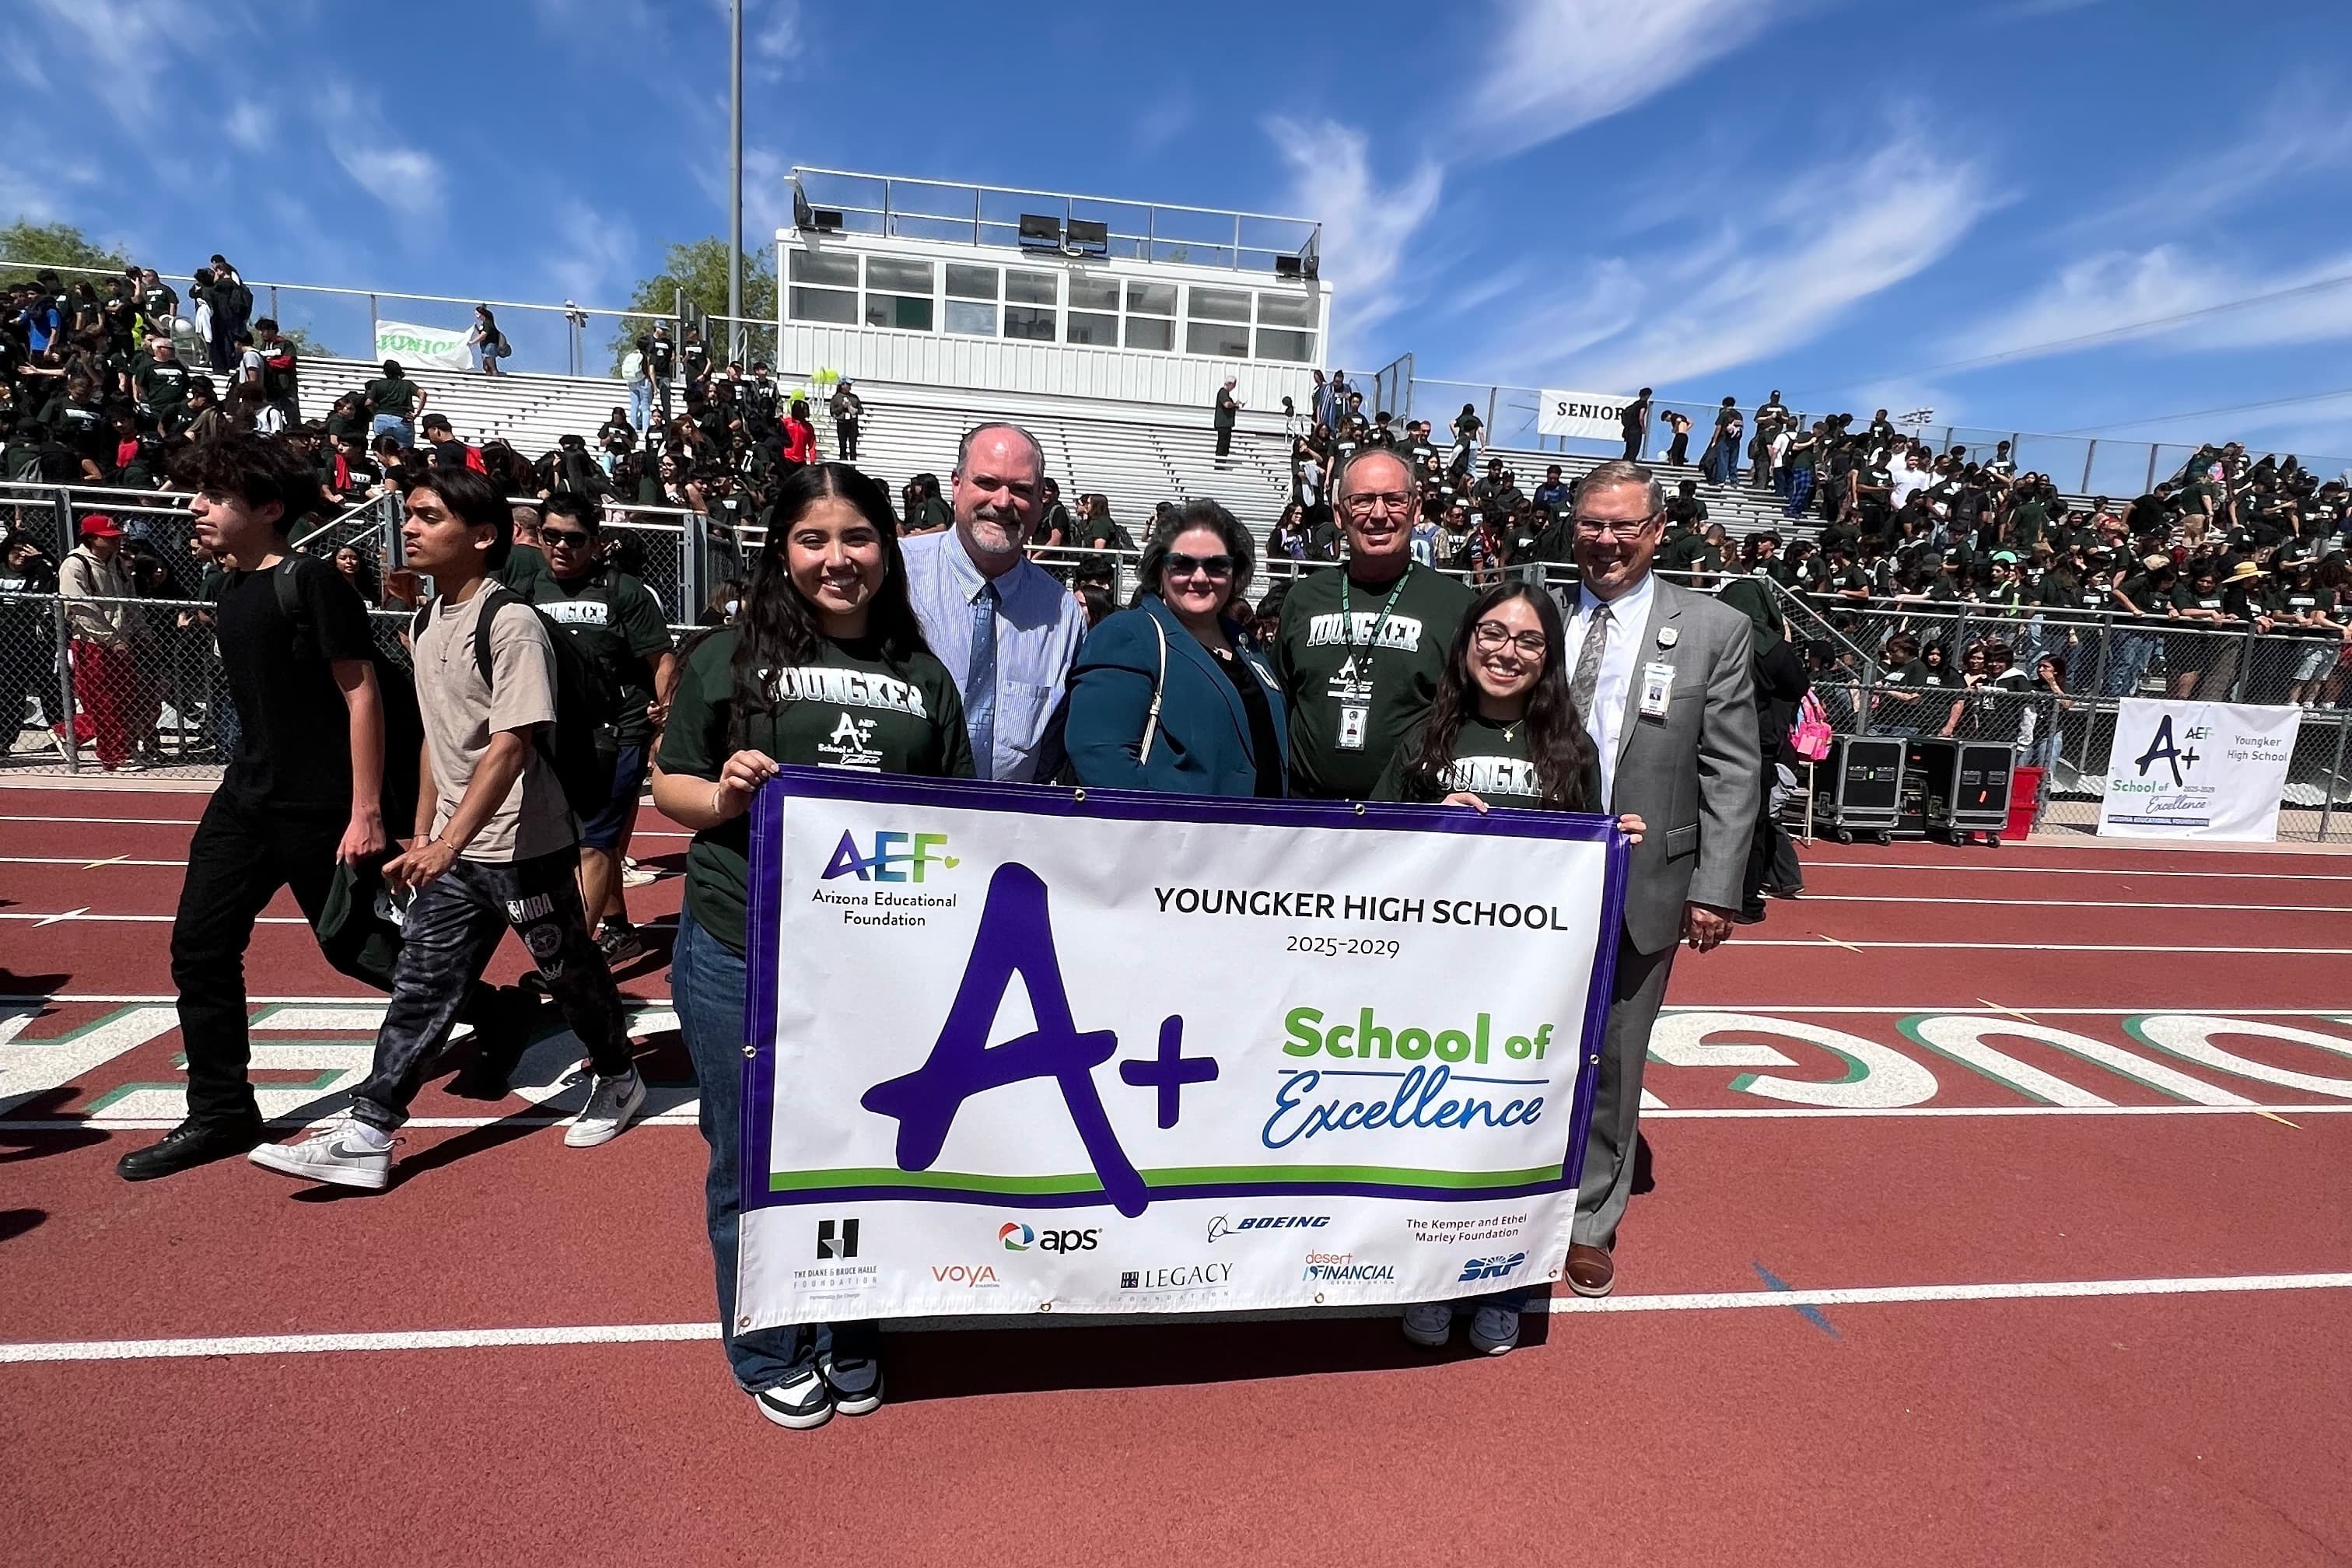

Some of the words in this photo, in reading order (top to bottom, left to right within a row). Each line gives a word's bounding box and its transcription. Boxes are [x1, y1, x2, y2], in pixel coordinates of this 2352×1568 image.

[2185, 726, 2214, 740] AEF
[2235, 735, 2282, 747] Youngker
[2227, 750, 2248, 762] High
[2252, 751, 2287, 762] School
[2112, 779, 2157, 793] School
[2158, 782, 2170, 792] of
[2146, 794, 2207, 814] Excellence
[821, 828, 948, 883] AEF
[811, 888, 869, 906] Arizona
[874, 891, 957, 907] Educational
[519, 893, 554, 922] NBA
[1154, 887, 1334, 919] YOUNGKER
[1343, 895, 1425, 923] HIGH
[1432, 900, 1568, 931] SCHOOL
[844, 910, 926, 926] Foundation
[1286, 935, 1400, 958] 2025-2029
[860, 861, 1219, 1218] A+
[1282, 1007, 1490, 1064] School
[1504, 1024, 1553, 1060] of
[1262, 1065, 1544, 1150] Excellence
[1237, 1216, 1331, 1230] BOEING
[1406, 1219, 1428, 1229] The
[1431, 1219, 1476, 1231] Kemper
[1478, 1216, 1498, 1227] and
[1501, 1213, 1528, 1225] Ethel
[1040, 1228, 1097, 1255] aps
[1415, 1232, 1456, 1244] Marley
[1458, 1228, 1519, 1241] Foundation
[1305, 1248, 1353, 1265] desert
[807, 1269, 828, 1277] DIANE
[835, 1266, 856, 1276] BRUCE
[857, 1265, 877, 1274] HALLE
[932, 1265, 997, 1288] VOYA
[1145, 1262, 1234, 1288] LEGACY
[1457, 1251, 1526, 1283] SRP
[793, 1276, 877, 1289] FOUNDATION
